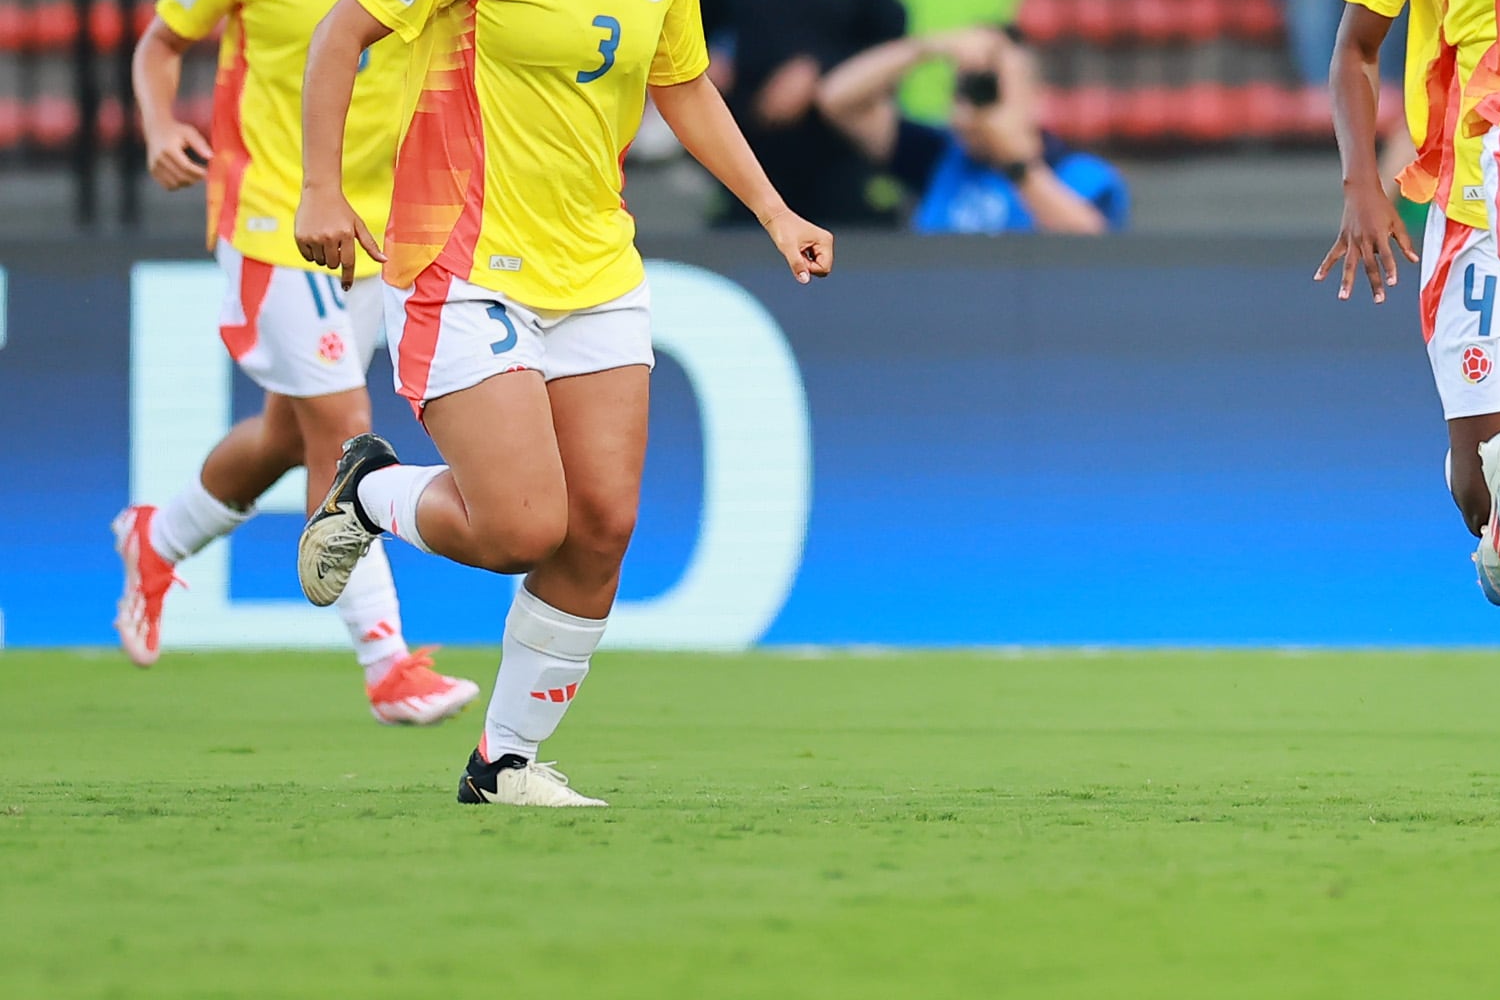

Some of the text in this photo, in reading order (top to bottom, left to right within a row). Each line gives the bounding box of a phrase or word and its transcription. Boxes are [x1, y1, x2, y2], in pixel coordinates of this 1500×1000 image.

[576, 14, 621, 84] 3
[485, 298, 518, 355] 3
[1463, 262, 1498, 337] 4
